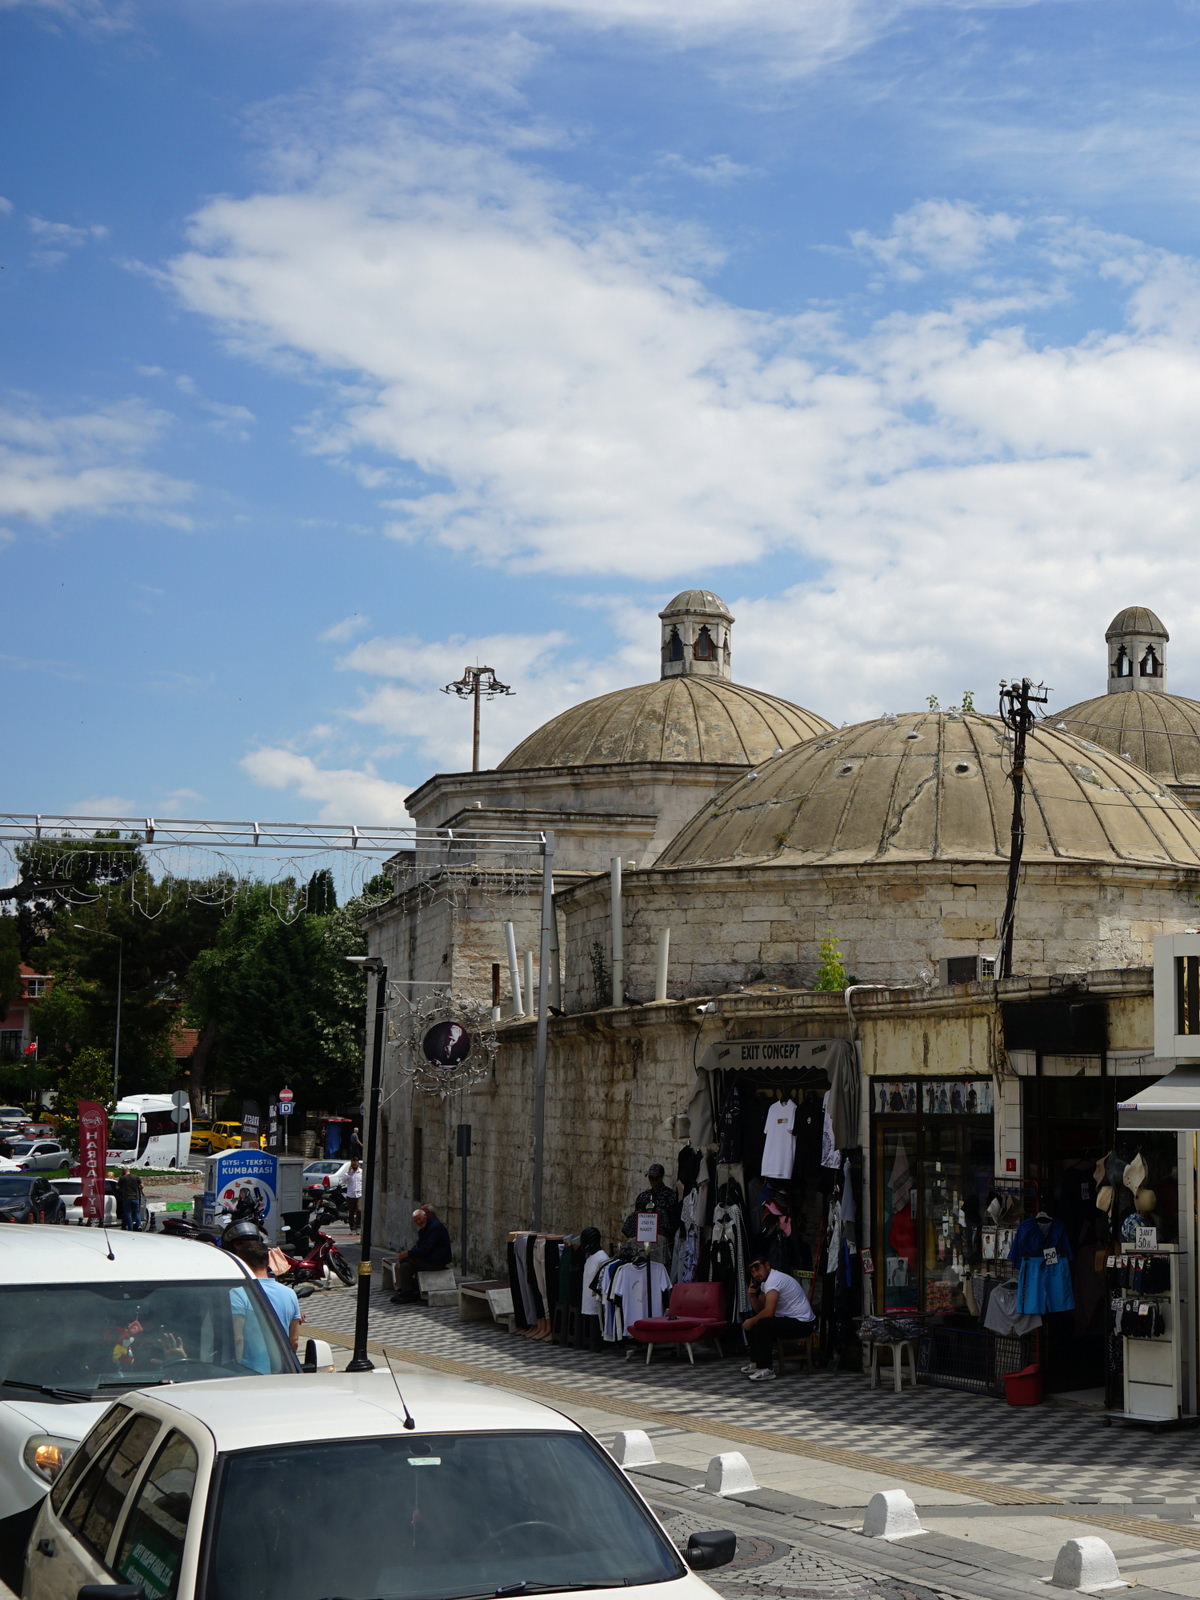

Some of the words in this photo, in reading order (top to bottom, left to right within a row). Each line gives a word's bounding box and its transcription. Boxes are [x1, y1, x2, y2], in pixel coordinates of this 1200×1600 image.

[741, 1045, 760, 1060] EXIT
[762, 1044, 801, 1060] CONCEPT
[283, 1104, 290, 1112] D
[222, 1166, 273, 1175] KUMBARASI
